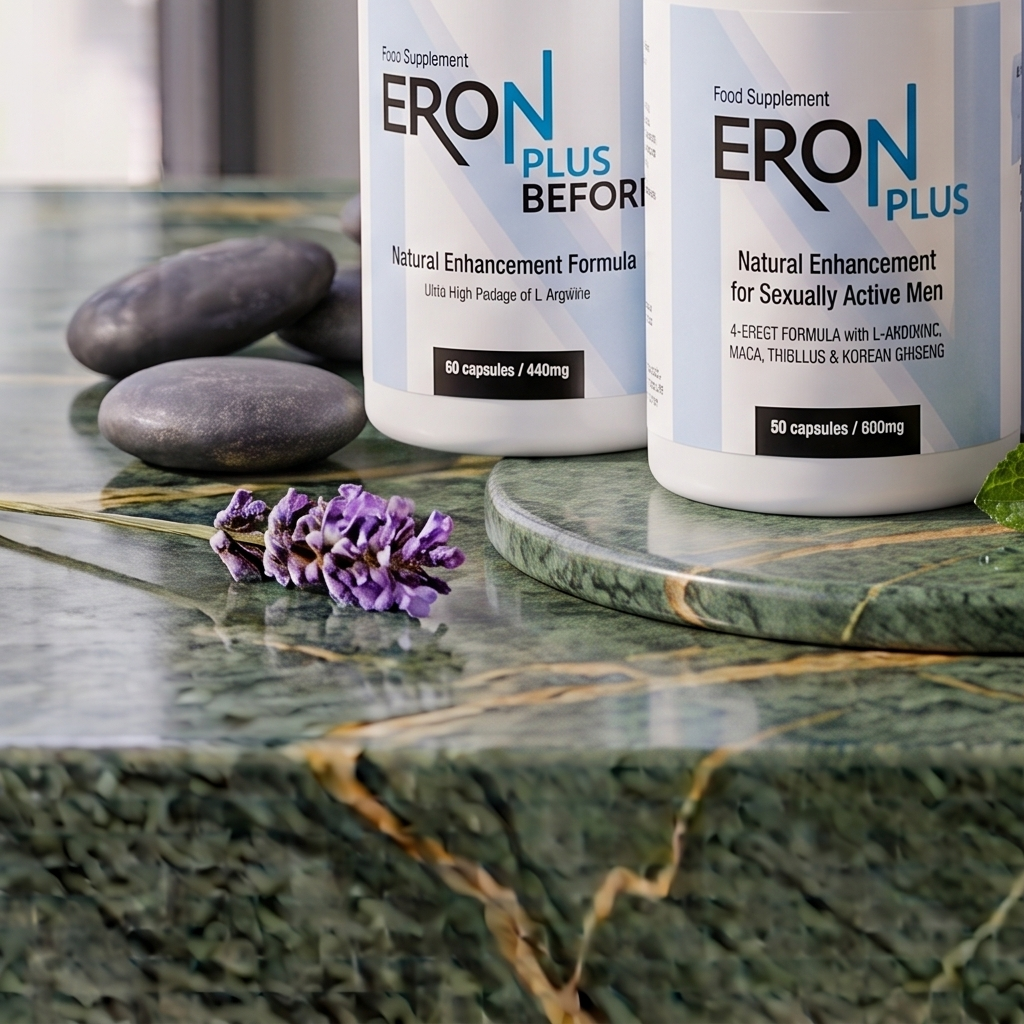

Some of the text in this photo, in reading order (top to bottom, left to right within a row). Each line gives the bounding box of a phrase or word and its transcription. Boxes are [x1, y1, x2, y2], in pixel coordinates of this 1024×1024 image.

[404, 48, 469, 69] Supplement
[383, 50, 552, 166] ERON
[714, 86, 830, 109] Food Supplement
[714, 83, 917, 212] ERON
[523, 146, 611, 178] PLUS
[887, 183, 969, 221] PLUS
[392, 245, 637, 275] Natural Enhancement Formula
[738, 250, 937, 275] Natural Enhancement
[449, 286, 472, 302] High
[520, 288, 532, 301] of
[535, 288, 542, 301] L
[731, 281, 943, 311] for Sexually Active Men
[782, 326, 841, 342] FORMULA
[844, 327, 869, 342] with
[729, 345, 764, 363] MACA,
[829, 349, 839, 364] &
[843, 347, 891, 364] KOREAN
[445, 360, 570, 379] 60 capsules / 440mg
[771, 419, 905, 438] 50 capsules / 600mg
